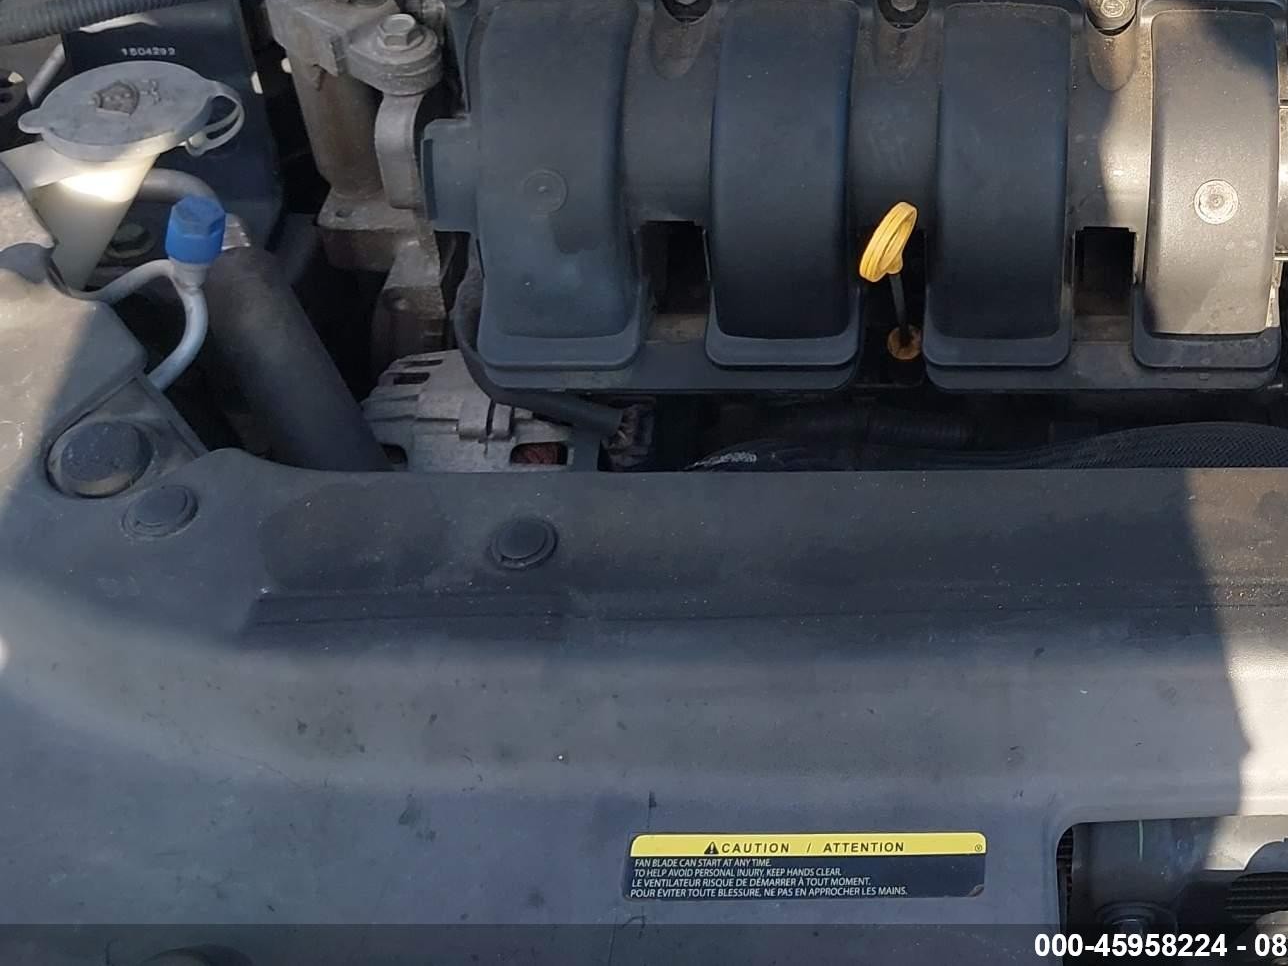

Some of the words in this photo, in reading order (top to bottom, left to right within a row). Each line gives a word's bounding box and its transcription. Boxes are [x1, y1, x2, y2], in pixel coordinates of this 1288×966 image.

[721, 842, 790, 854] CAUTION
[823, 841, 905, 853] ATTENTION
[634, 858, 651, 868] FAN
[652, 858, 678, 868] BLADE
[679, 858, 697, 867] CAN
[697, 858, 721, 867] START
[723, 858, 733, 867] AT
[733, 858, 752, 867] ANY
[752, 858, 772, 867] TIME.
[634, 868, 646, 878] TO
[646, 868, 667, 878] HELP
[669, 867, 694, 878] AVOID
[694, 868, 735, 877] PERSONAL
[736, 868, 765, 878] INJURY,
[766, 868, 786, 877] KEEP
[786, 867, 814, 877] HANDS
[815, 867, 842, 877] CLEAR.
[631, 878, 642, 888] LE
[643, 878, 704, 888] VENTILATEUR
[703, 878, 734, 888] RISQUE
[735, 878, 747, 887] DE
[749, 875, 797, 887] DÉMARRER
[799, 875, 804, 886] À
[806, 877, 830, 887] TOUT
[830, 877, 871, 886] MOMENT.
[630, 888, 656, 898] POUR
[657, 886, 687, 898] ÉVITER
[688, 888, 717, 898] TOUTE
[717, 887, 761, 898] BLESSURE,
[763, 887, 777, 897] NE
[777, 887, 794, 897] PAS
[795, 887, 807, 897] EN
[809, 887, 860, 897] APPROCHER
[861, 887, 876, 896] LES
[878, 886, 908, 896] MAINS.
